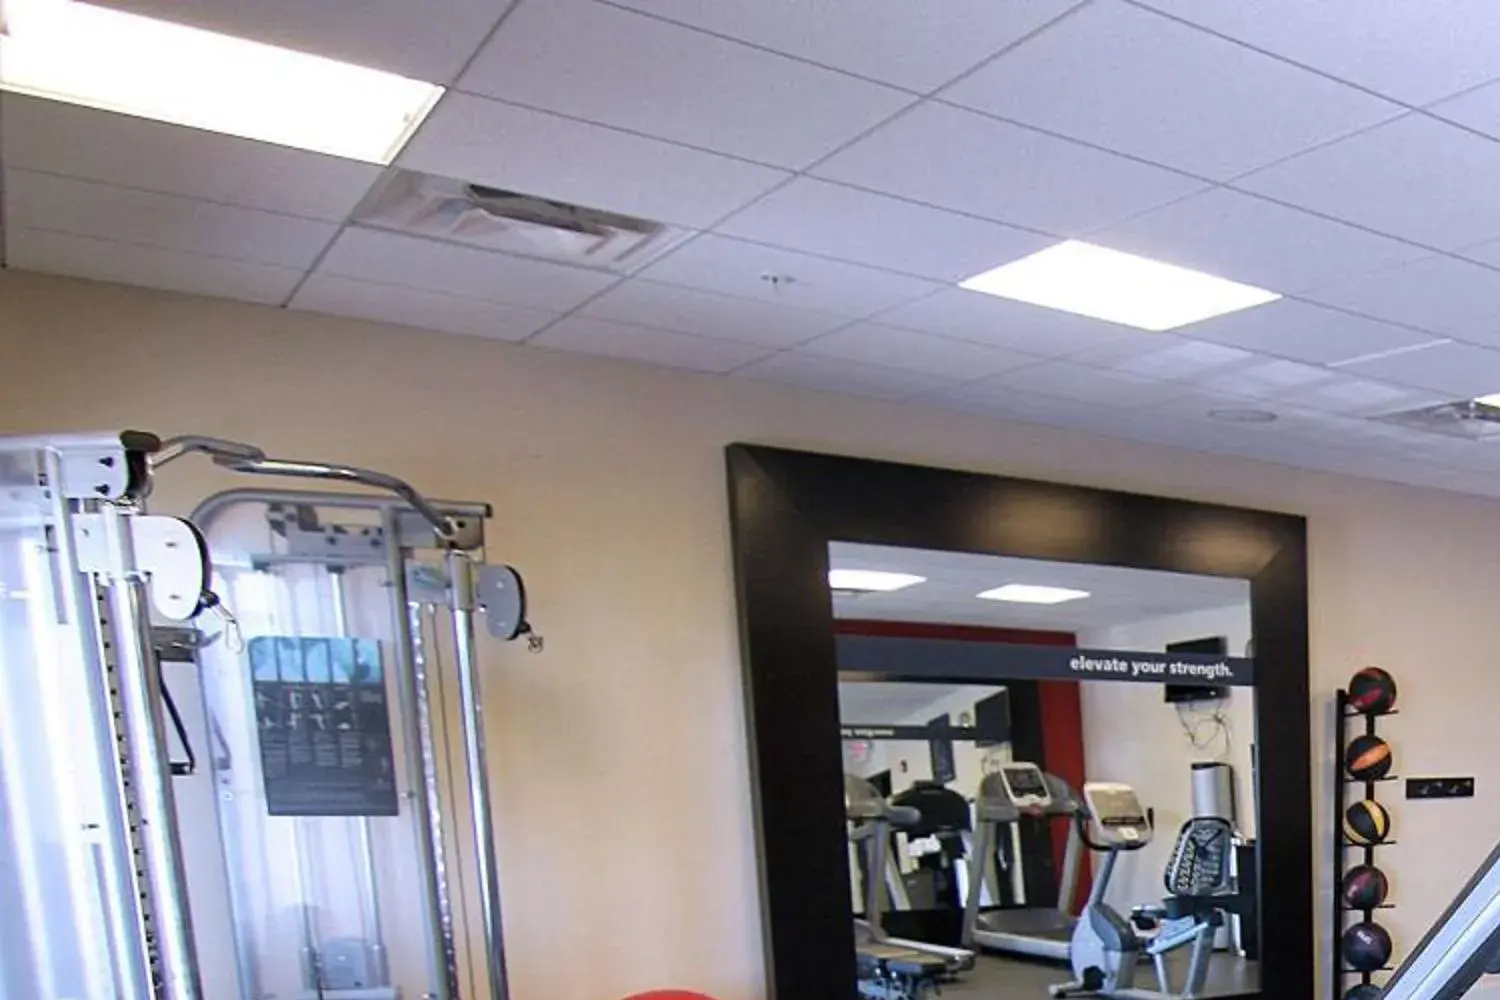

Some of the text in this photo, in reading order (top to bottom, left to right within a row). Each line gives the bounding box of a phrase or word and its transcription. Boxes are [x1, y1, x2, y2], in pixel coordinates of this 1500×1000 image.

[1070, 655, 1234, 679] elevate your strength.
